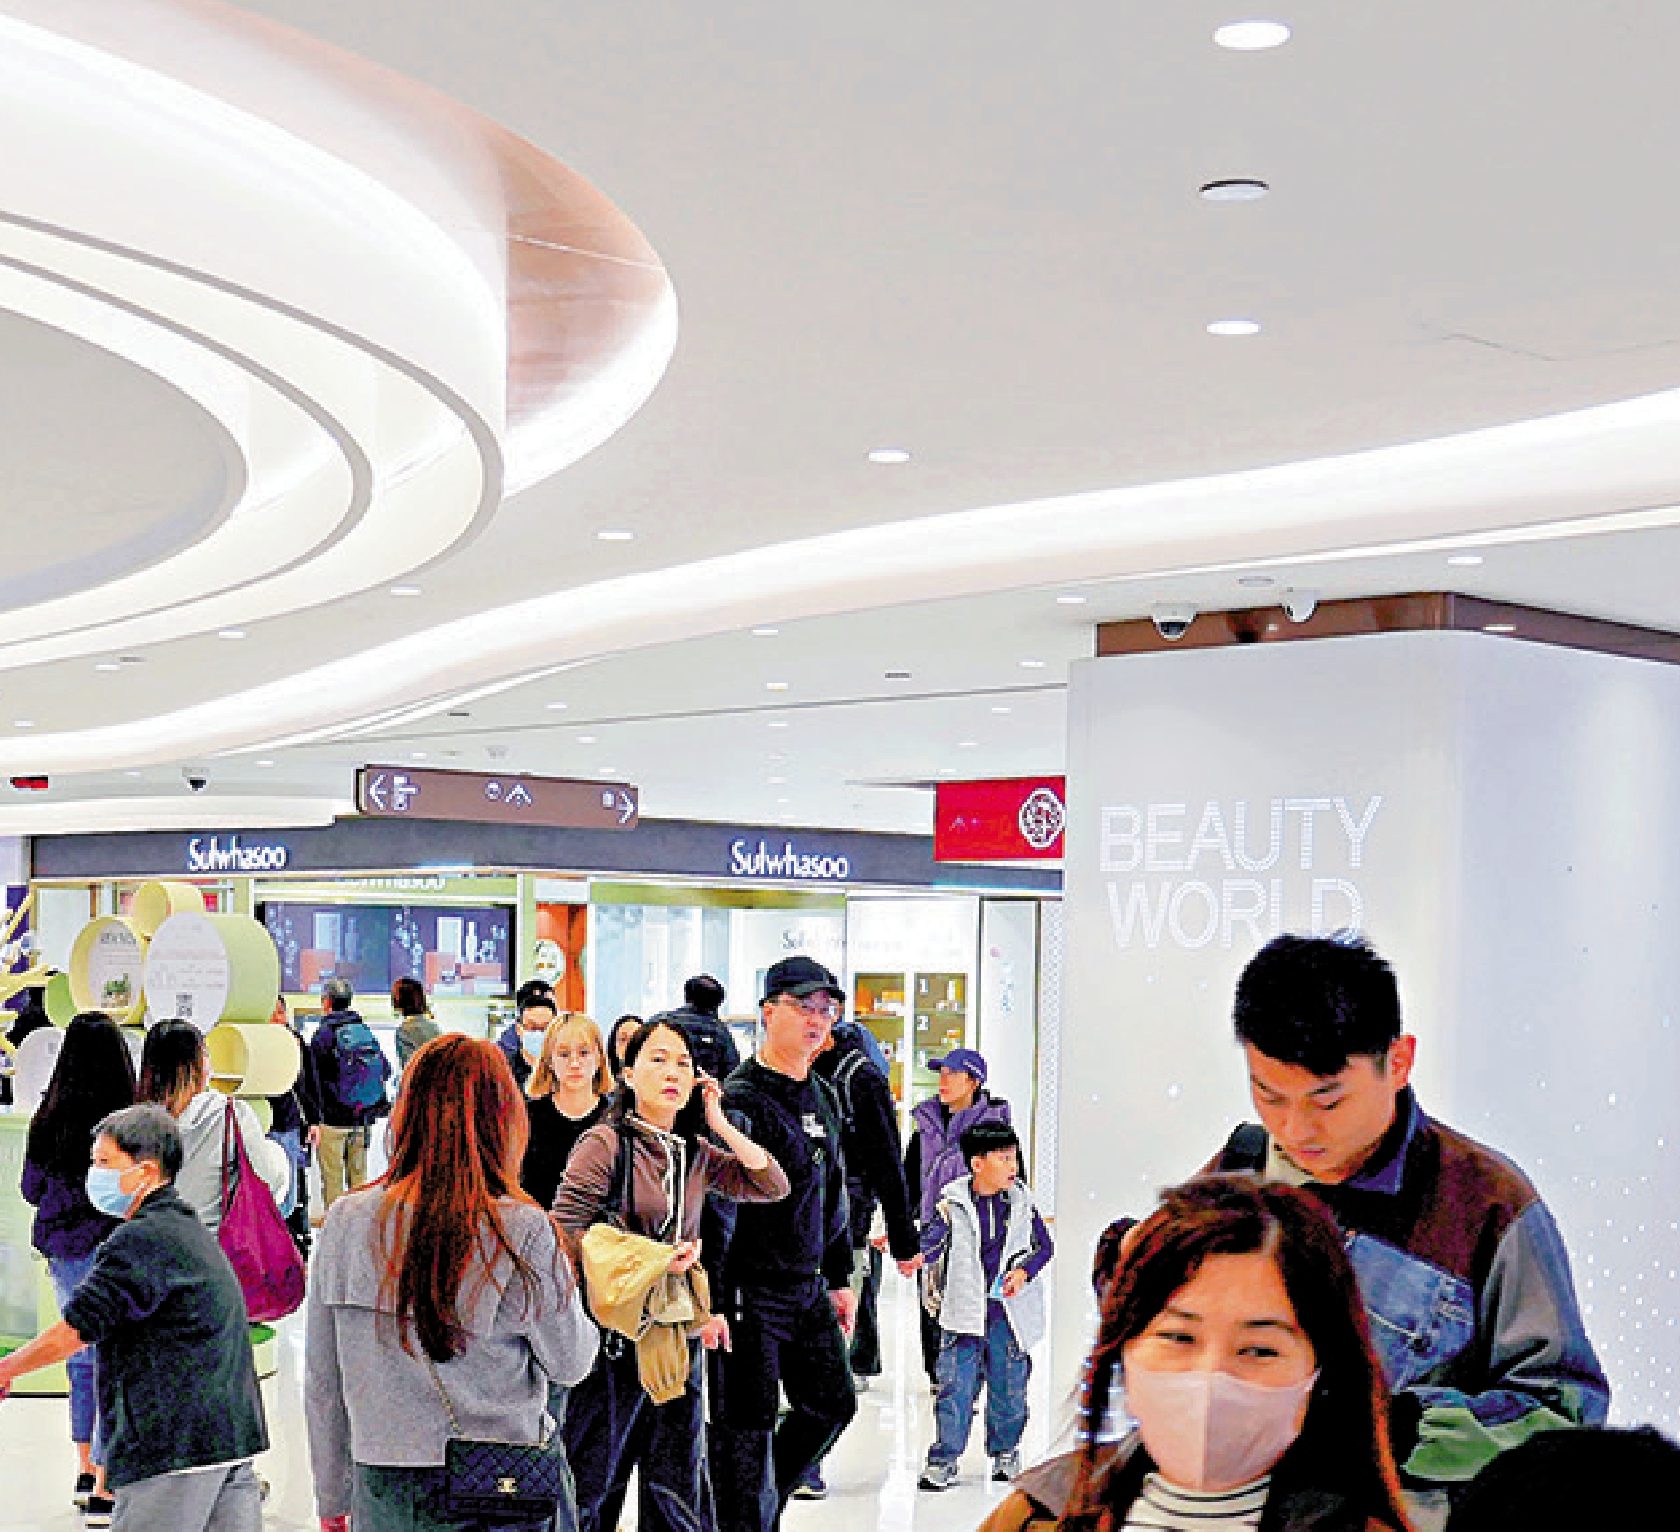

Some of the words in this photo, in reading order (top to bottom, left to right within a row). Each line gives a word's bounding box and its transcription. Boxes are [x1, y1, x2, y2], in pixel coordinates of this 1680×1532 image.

[1099, 795, 1382, 872] BEAUTY
[188, 836, 288, 871] Sulwhasoo
[731, 840, 849, 877] Sulwhasoo
